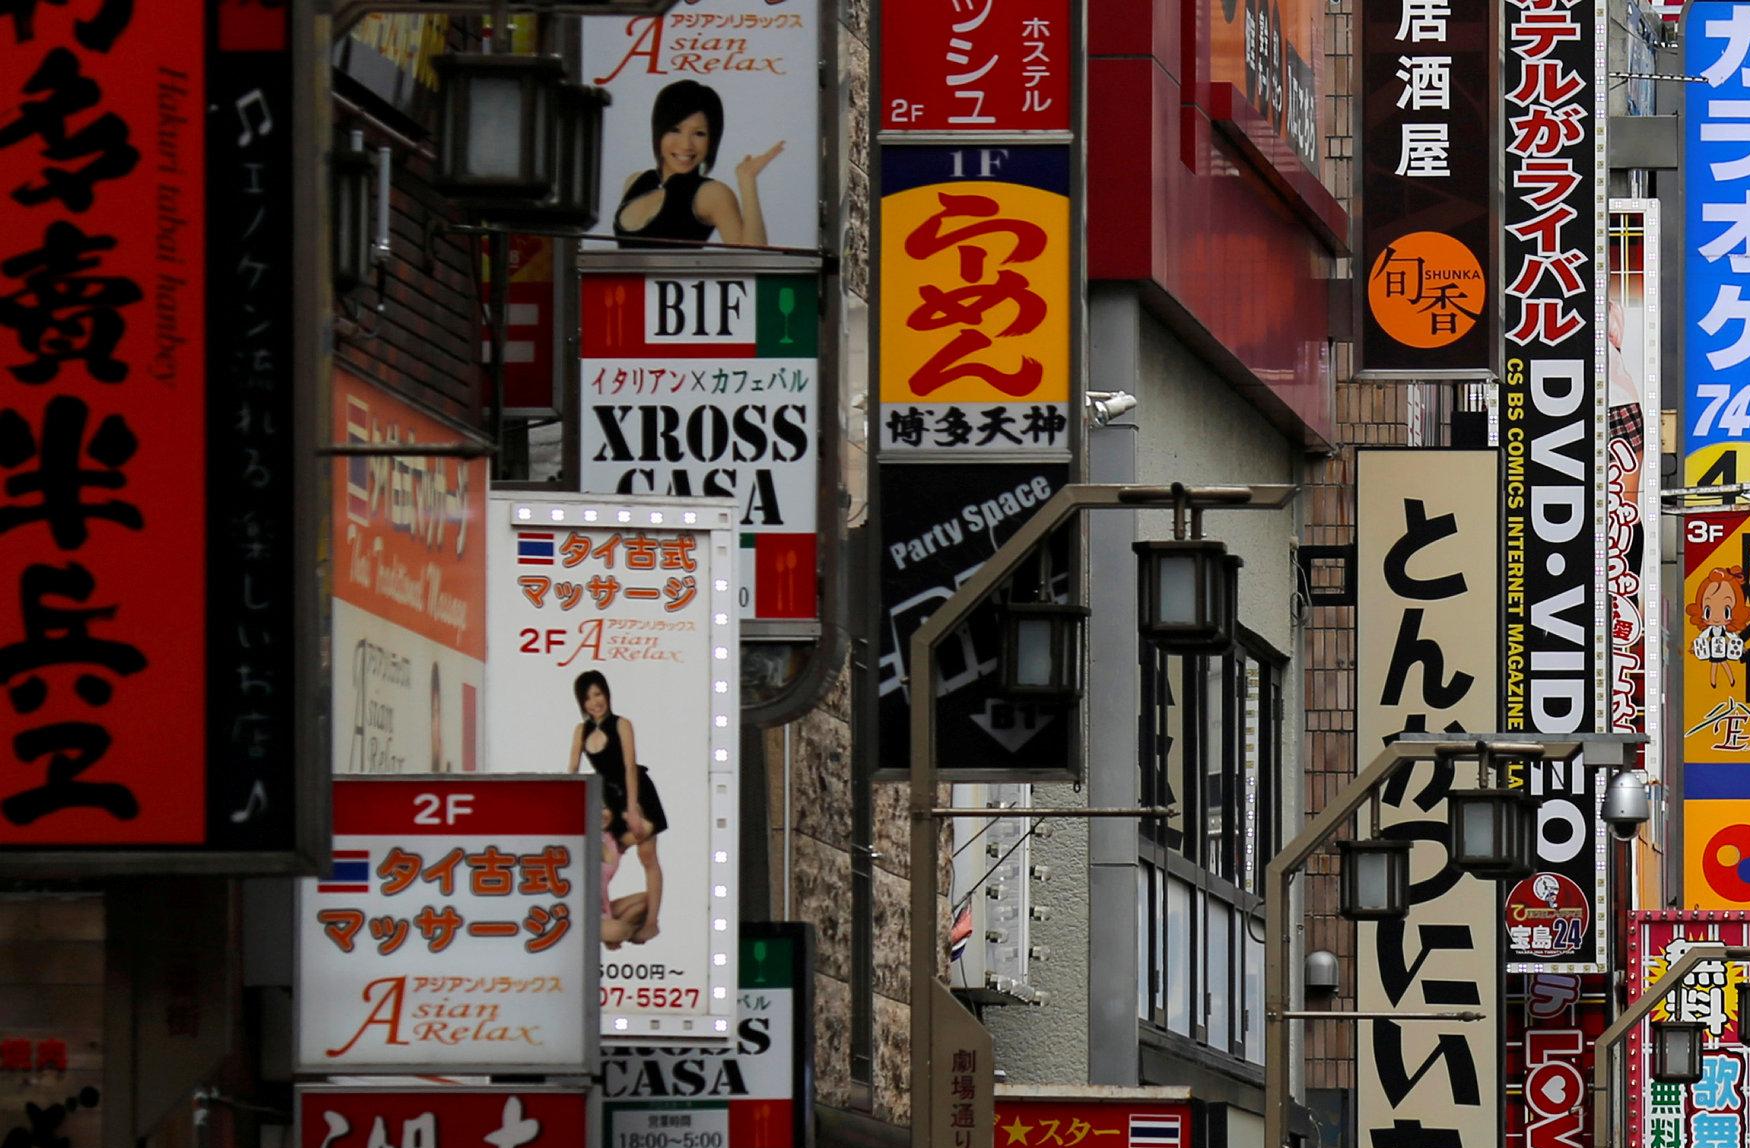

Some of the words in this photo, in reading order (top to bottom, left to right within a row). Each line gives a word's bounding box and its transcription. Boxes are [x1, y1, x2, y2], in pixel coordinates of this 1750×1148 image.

[1022, 17, 1052, 113] ホステル
[890, 98, 925, 124] 2F
[949, 149, 1010, 178] 1F
[904, 192, 1048, 398] らーめん
[1425, 269, 1482, 281] SHUNKA
[654, 280, 748, 338] B1F
[1505, 358, 1524, 385] CS
[886, 404, 1068, 448] 博多天神
[1505, 392, 1524, 422] BS
[593, 404, 809, 463] XROSS
[1505, 430, 1525, 508] COMICS
[889, 516, 964, 570] Party
[960, 475, 1052, 551] Space
[1686, 521, 1724, 544] 3F
[558, 531, 698, 571] タイ古式
[1506, 515, 1524, 617] INTERNET
[516, 575, 698, 612] マッサージ
[518, 628, 567, 655] 2F
[1506, 623, 1524, 731] MAGAZINE
[413, 794, 476, 826] 2F
[376, 846, 573, 897] タイ古式
[317, 904, 573, 955] マッサージ
[1034, 1117, 1122, 1148] スター
